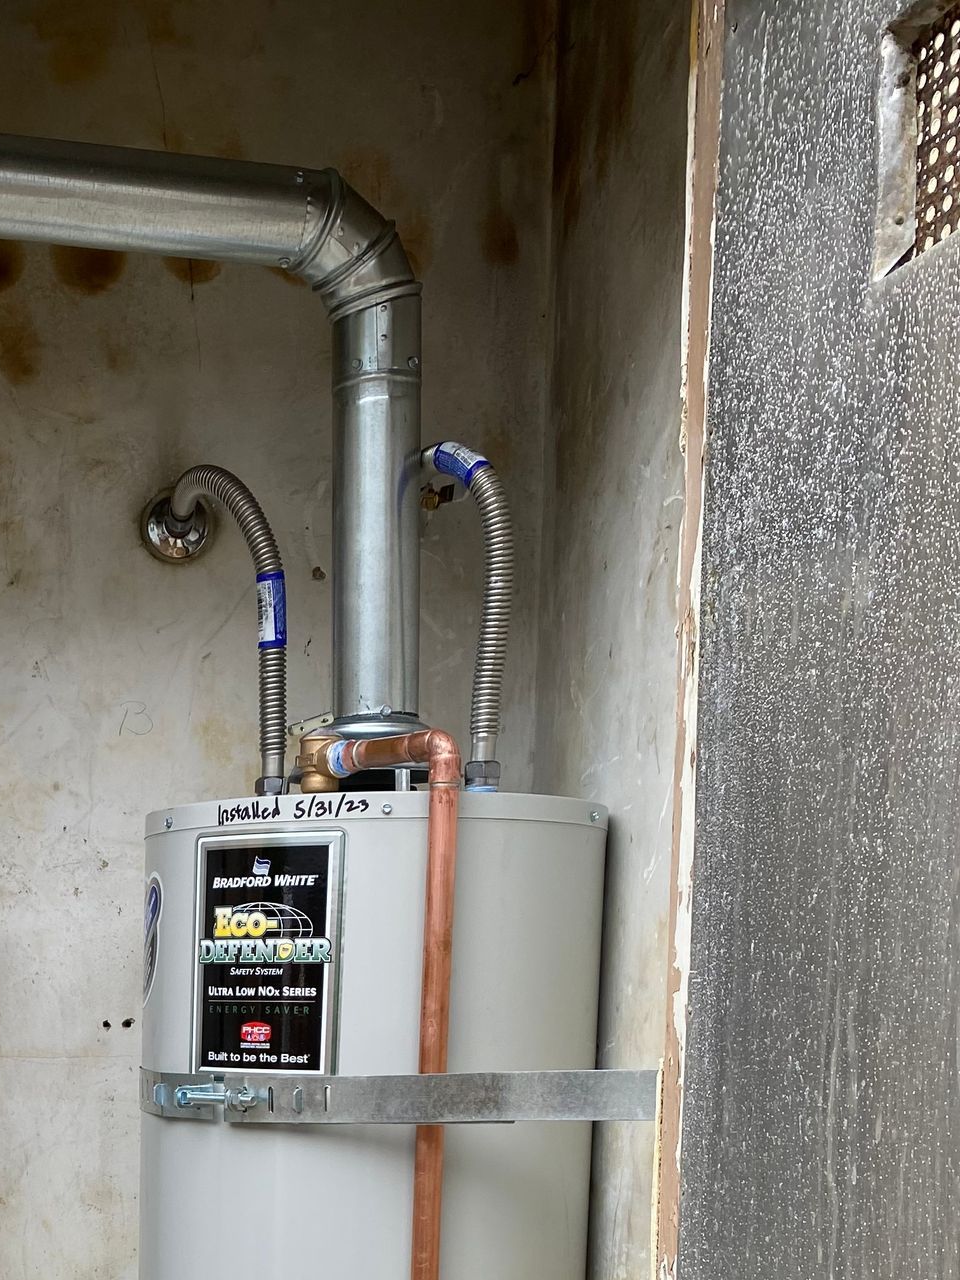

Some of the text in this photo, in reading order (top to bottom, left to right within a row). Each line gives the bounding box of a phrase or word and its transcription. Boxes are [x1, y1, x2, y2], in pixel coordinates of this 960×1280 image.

[219, 794, 369, 825] Installed 5/31/23
[212, 875, 315, 889] BRADFORD WHITE
[200, 938, 331, 963] DEFENDER
[230, 967, 283, 975] SAFETY SYSTEM
[208, 986, 234, 996] ULTRA
[236, 986, 256, 996] LOW
[282, 986, 317, 997] SERIES
[242, 1026, 270, 1034] PHCC
[208, 1051, 310, 1063] Built to be the Best
